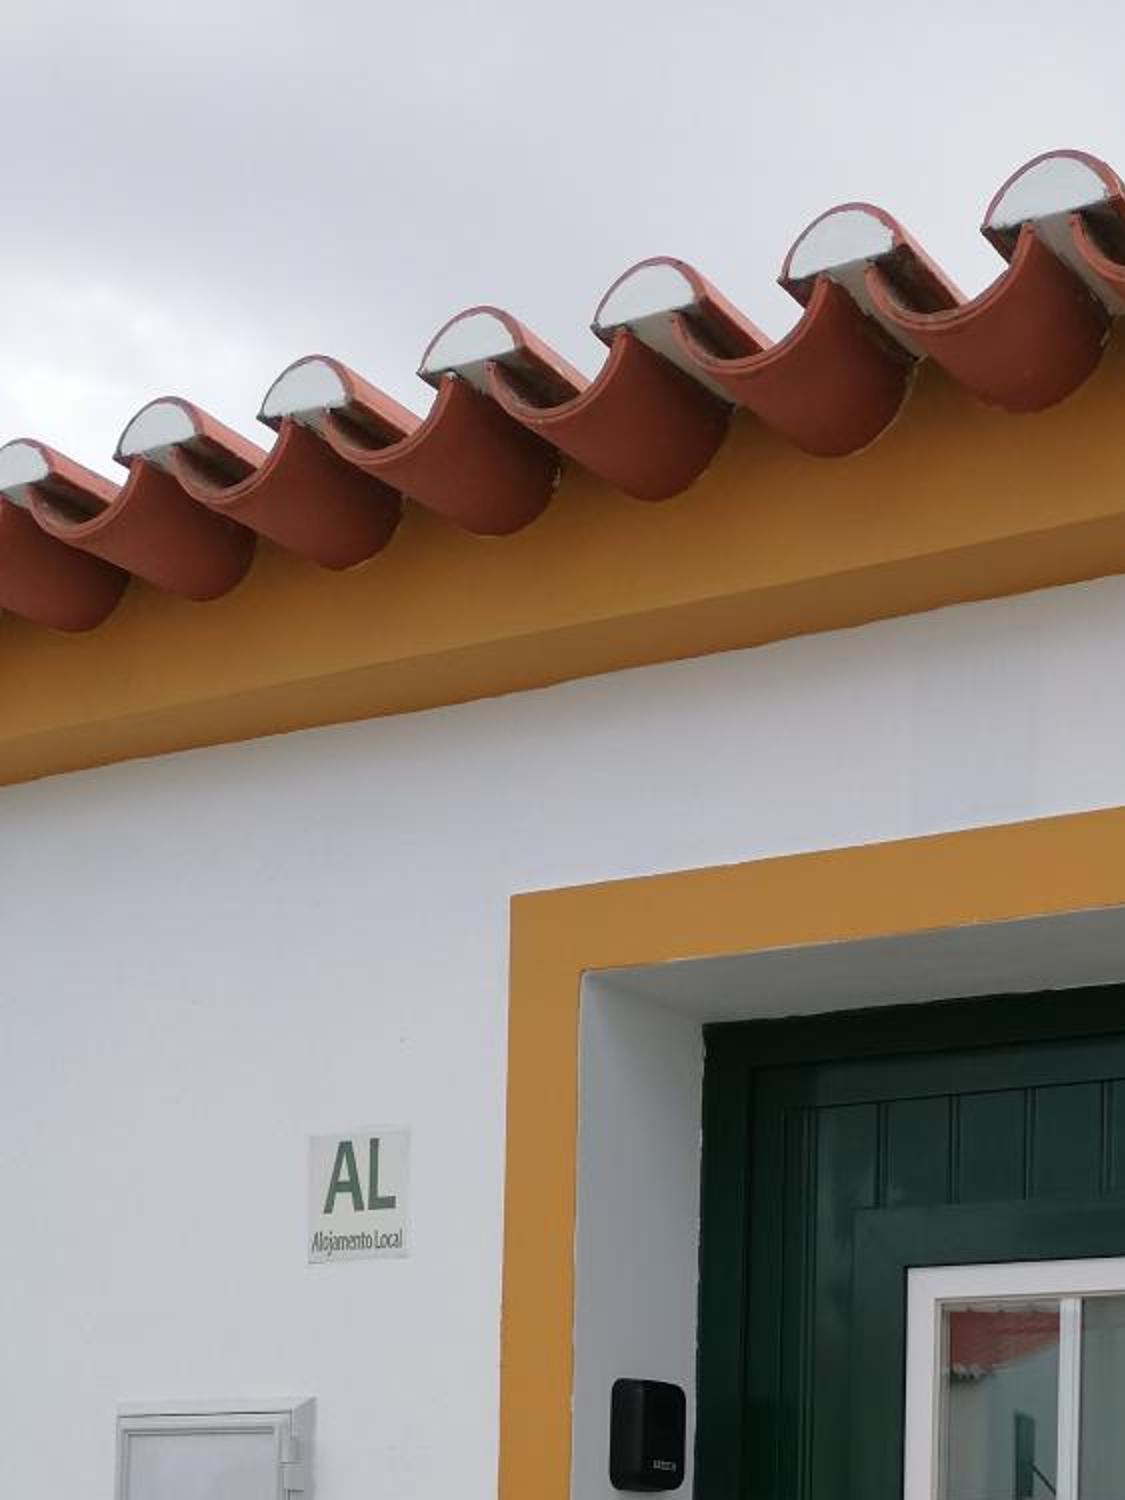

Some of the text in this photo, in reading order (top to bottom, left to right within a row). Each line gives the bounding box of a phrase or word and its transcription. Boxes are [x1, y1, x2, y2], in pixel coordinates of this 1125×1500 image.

[323, 1137, 397, 1215] AL
[311, 1227, 404, 1257] Alojamento Local
